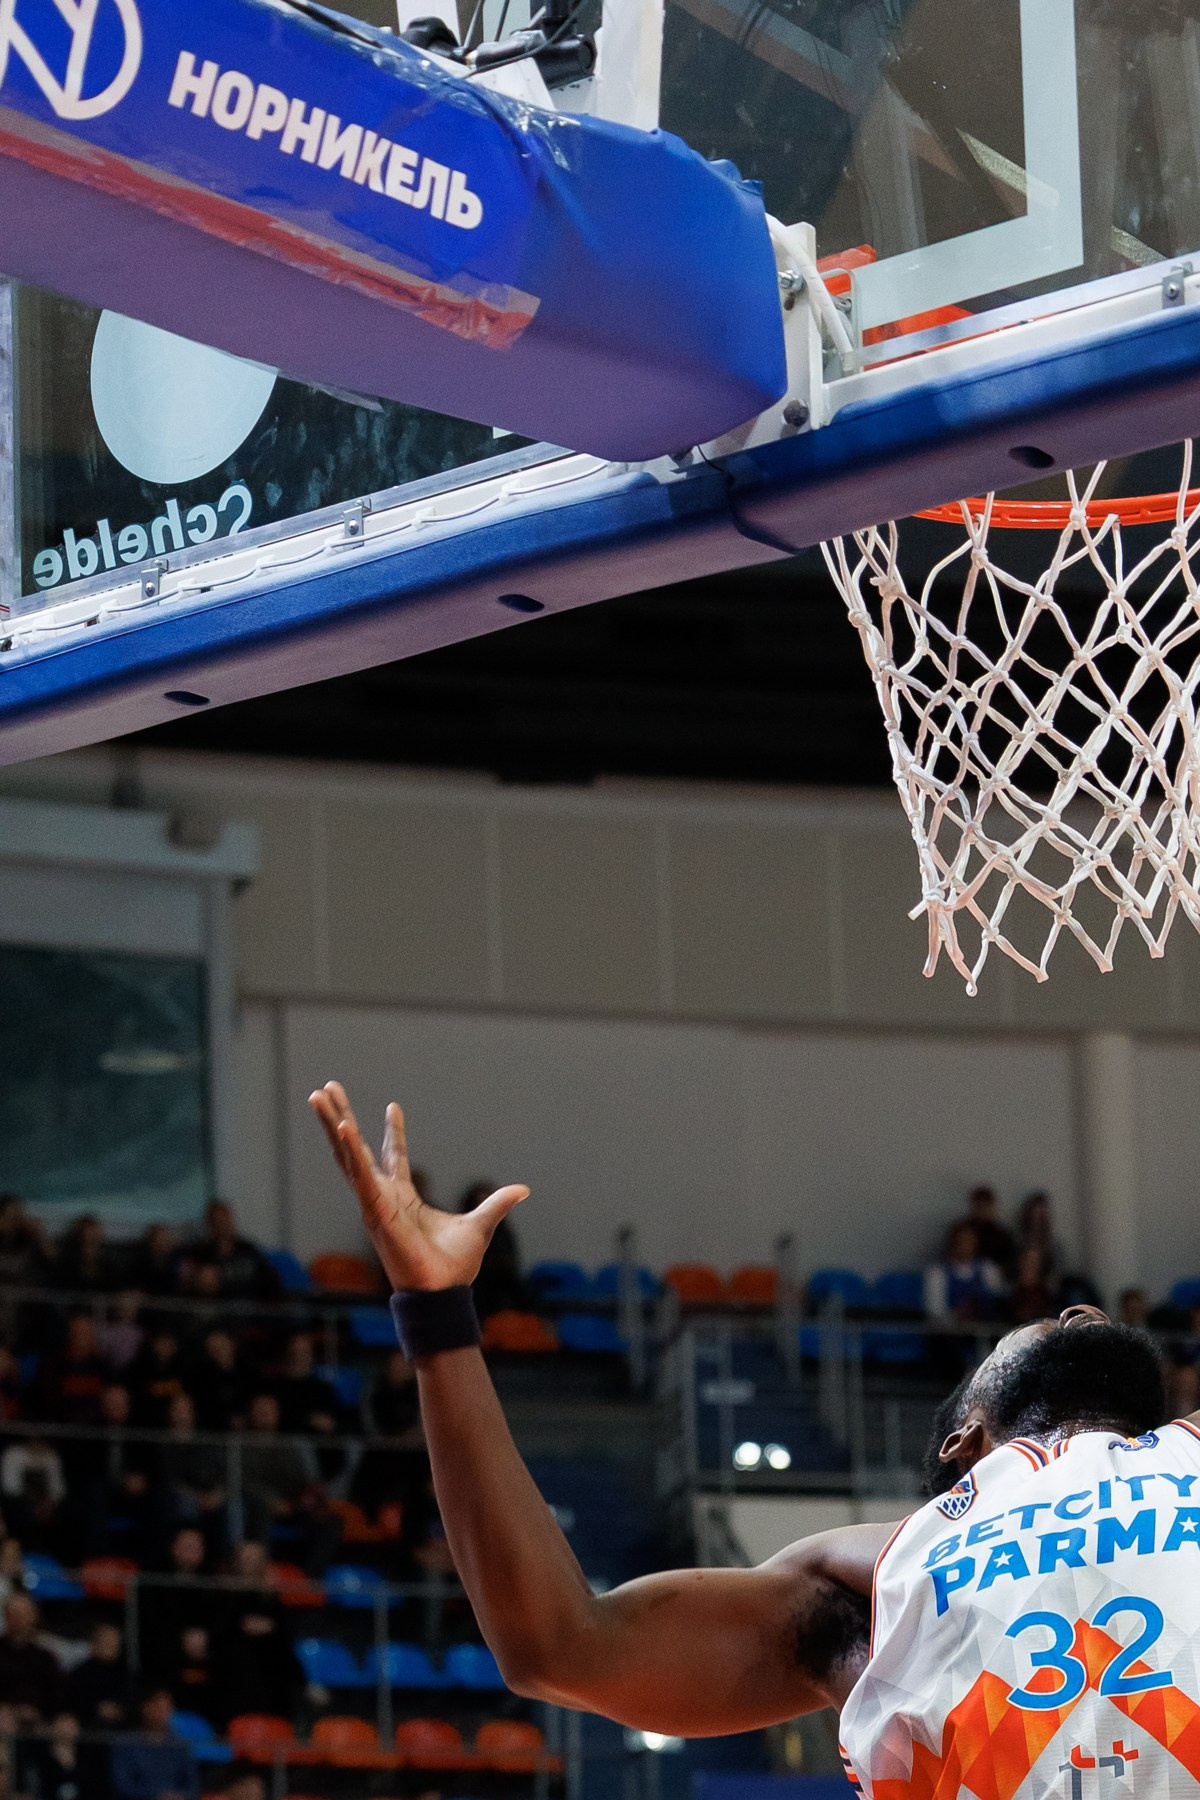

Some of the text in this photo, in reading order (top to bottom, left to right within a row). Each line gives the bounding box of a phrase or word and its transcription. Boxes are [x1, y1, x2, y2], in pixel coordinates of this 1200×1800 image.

[168, 51, 484, 230] НОРНИКЕЛЬ
[922, 1472, 1199, 1570] BETCITY
[1005, 1596, 1175, 1711] 32
